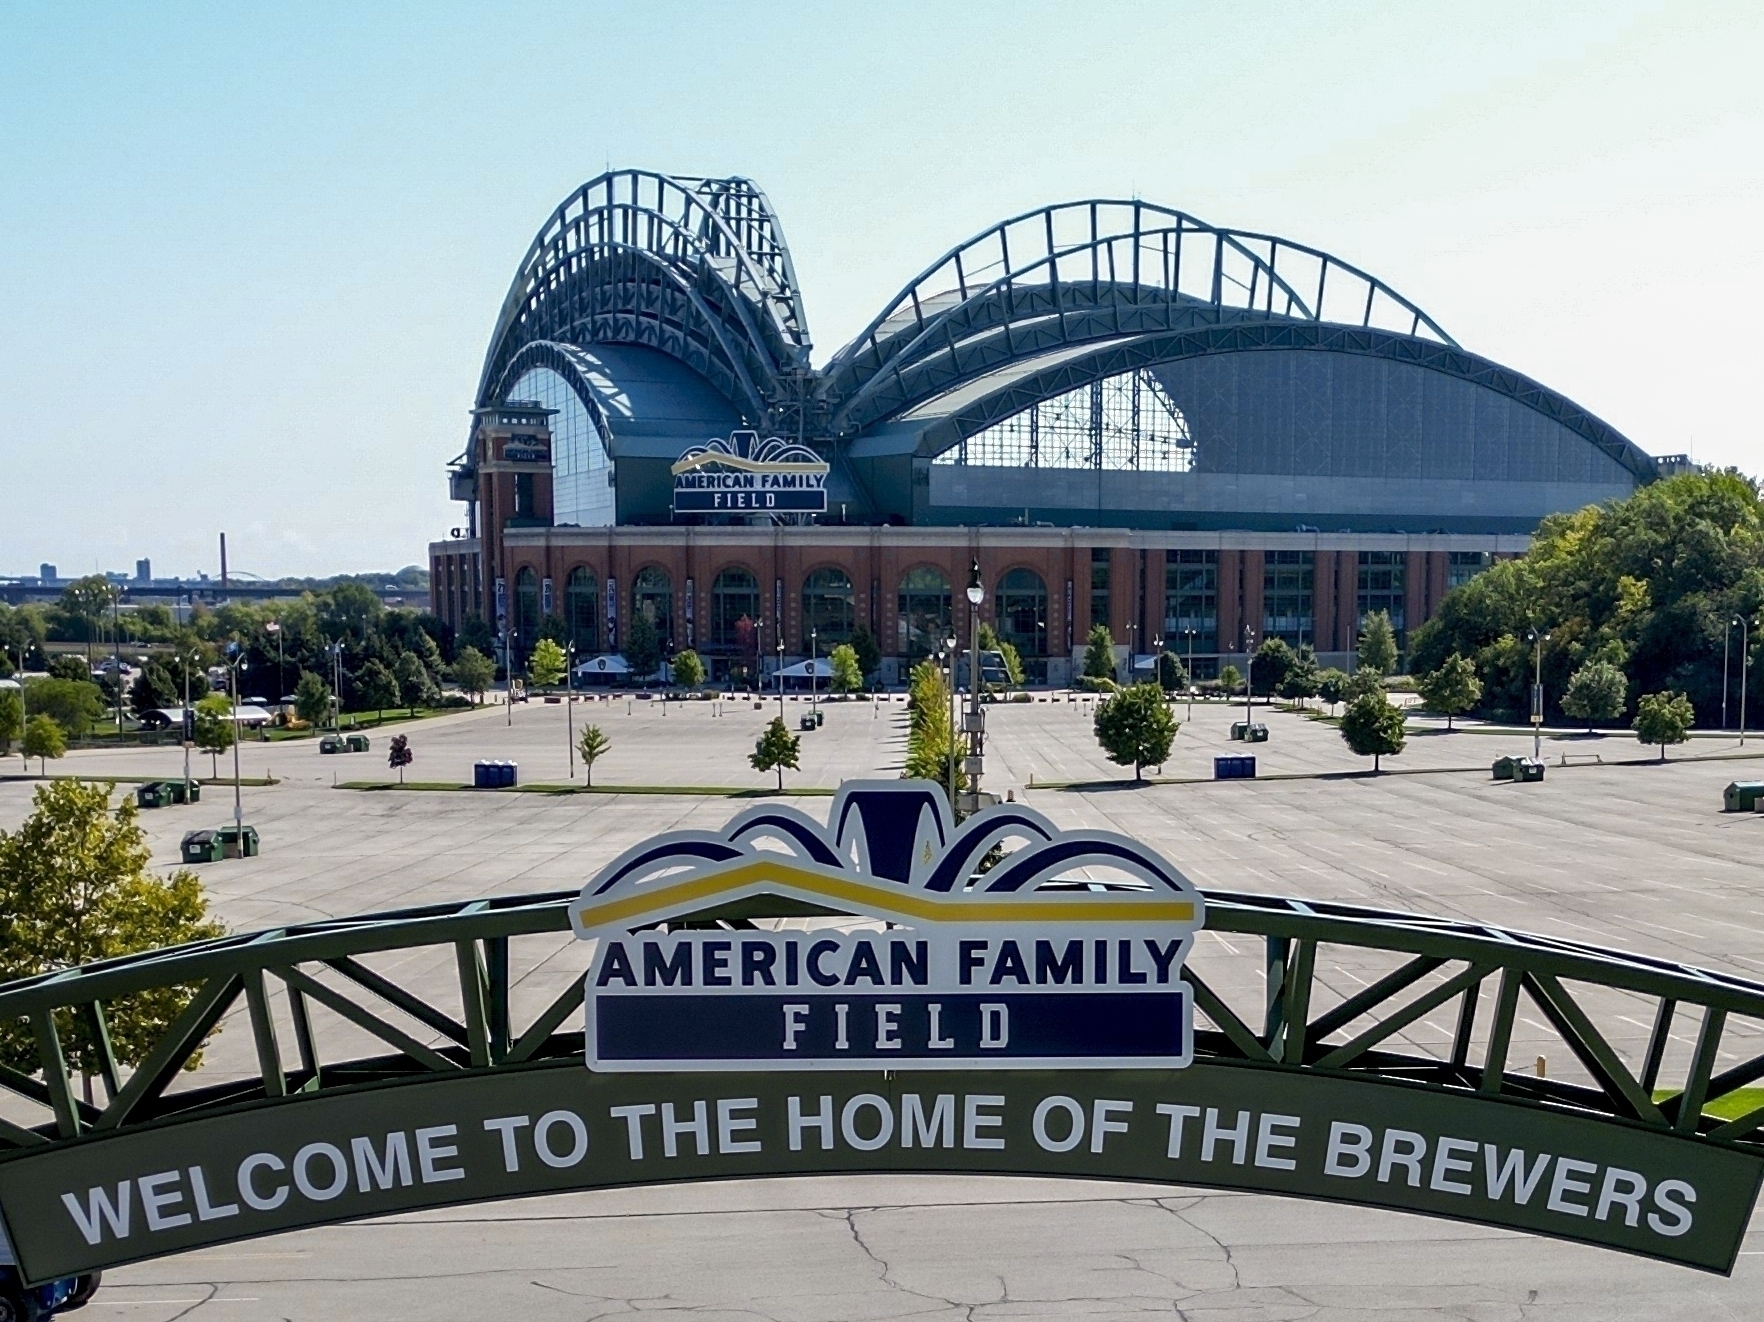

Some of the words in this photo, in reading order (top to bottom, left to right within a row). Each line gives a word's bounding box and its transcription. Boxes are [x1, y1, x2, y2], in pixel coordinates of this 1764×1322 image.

[674, 474, 755, 489] AMERICAN
[761, 474, 825, 488] FAMILY
[713, 493, 776, 508] FIELD
[596, 940, 929, 987] AMERICAN
[958, 939, 1184, 986] FAMILY
[782, 1003, 1009, 1050] FIELD
[60, 1124, 466, 1245] WELCOME
[483, 1110, 588, 1172] TO
[610, 1097, 762, 1160] THE
[787, 1093, 1006, 1151] HOME
[1032, 1095, 1134, 1154] OF
[1155, 1103, 1301, 1171] THE
[1323, 1121, 1698, 1237] BREWERS
